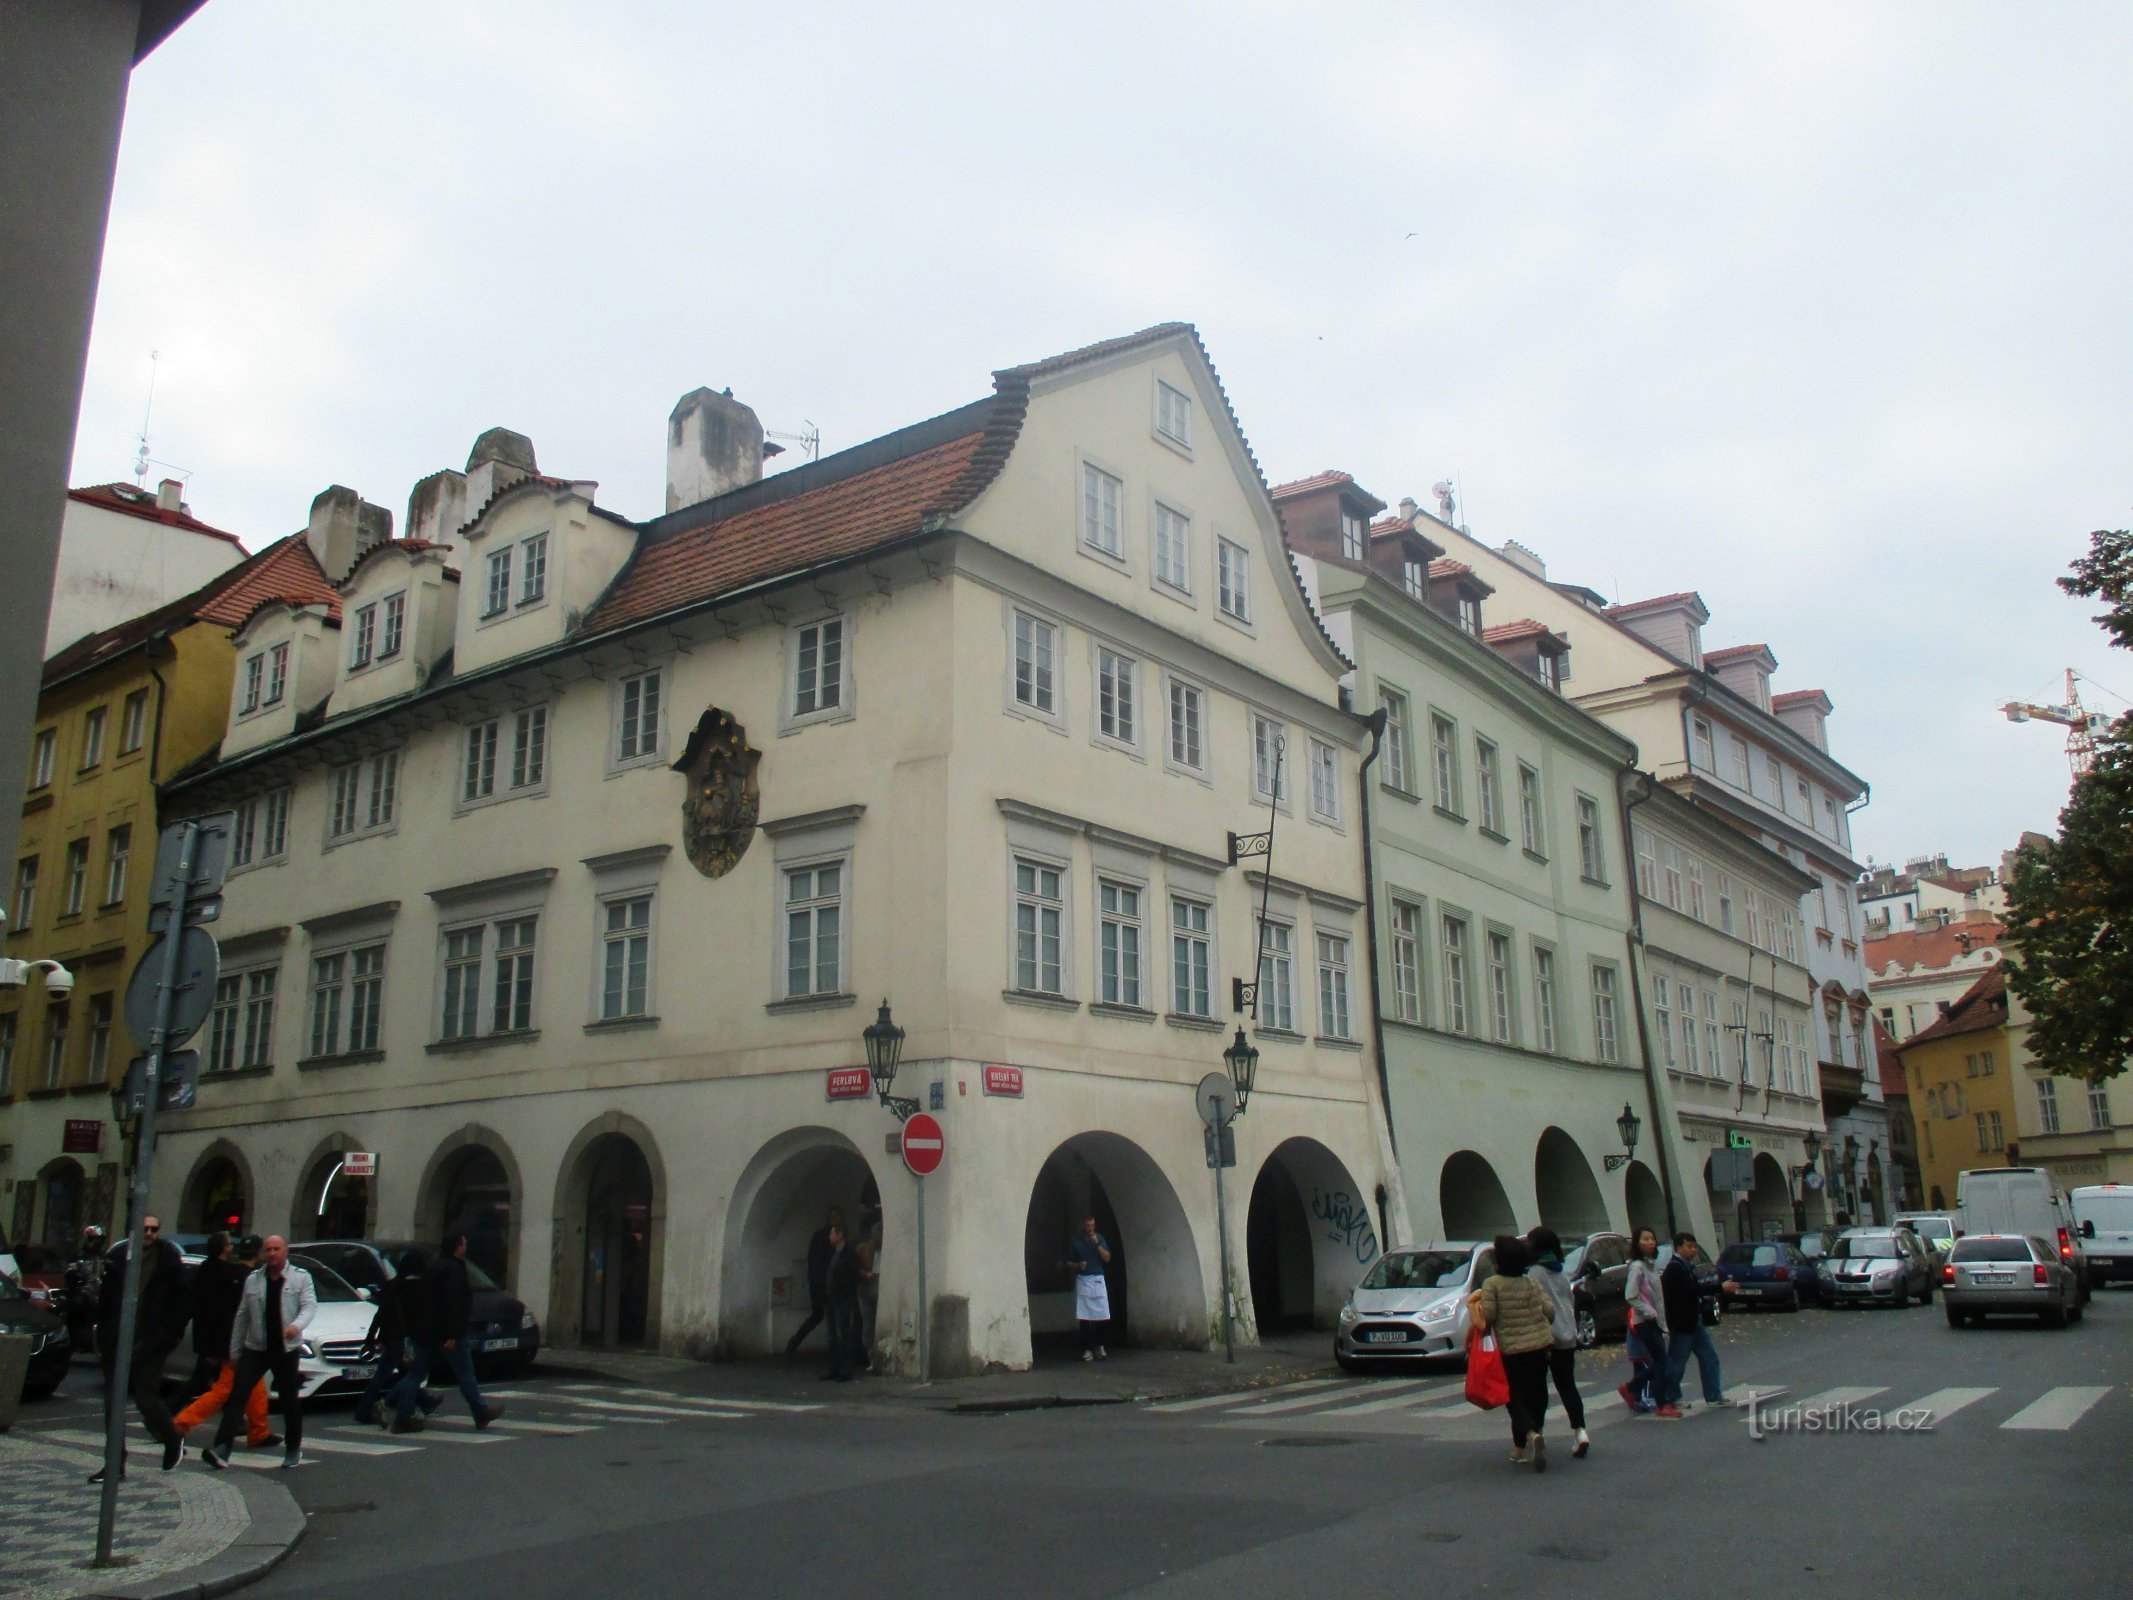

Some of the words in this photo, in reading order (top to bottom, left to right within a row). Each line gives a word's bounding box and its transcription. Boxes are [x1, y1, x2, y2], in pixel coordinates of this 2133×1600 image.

[832, 1072, 862, 1086] PERLOVÁ
[71, 1122, 98, 1131] NAILS
[352, 1154, 369, 1162] MINI
[345, 1165, 374, 1174] MARKET
